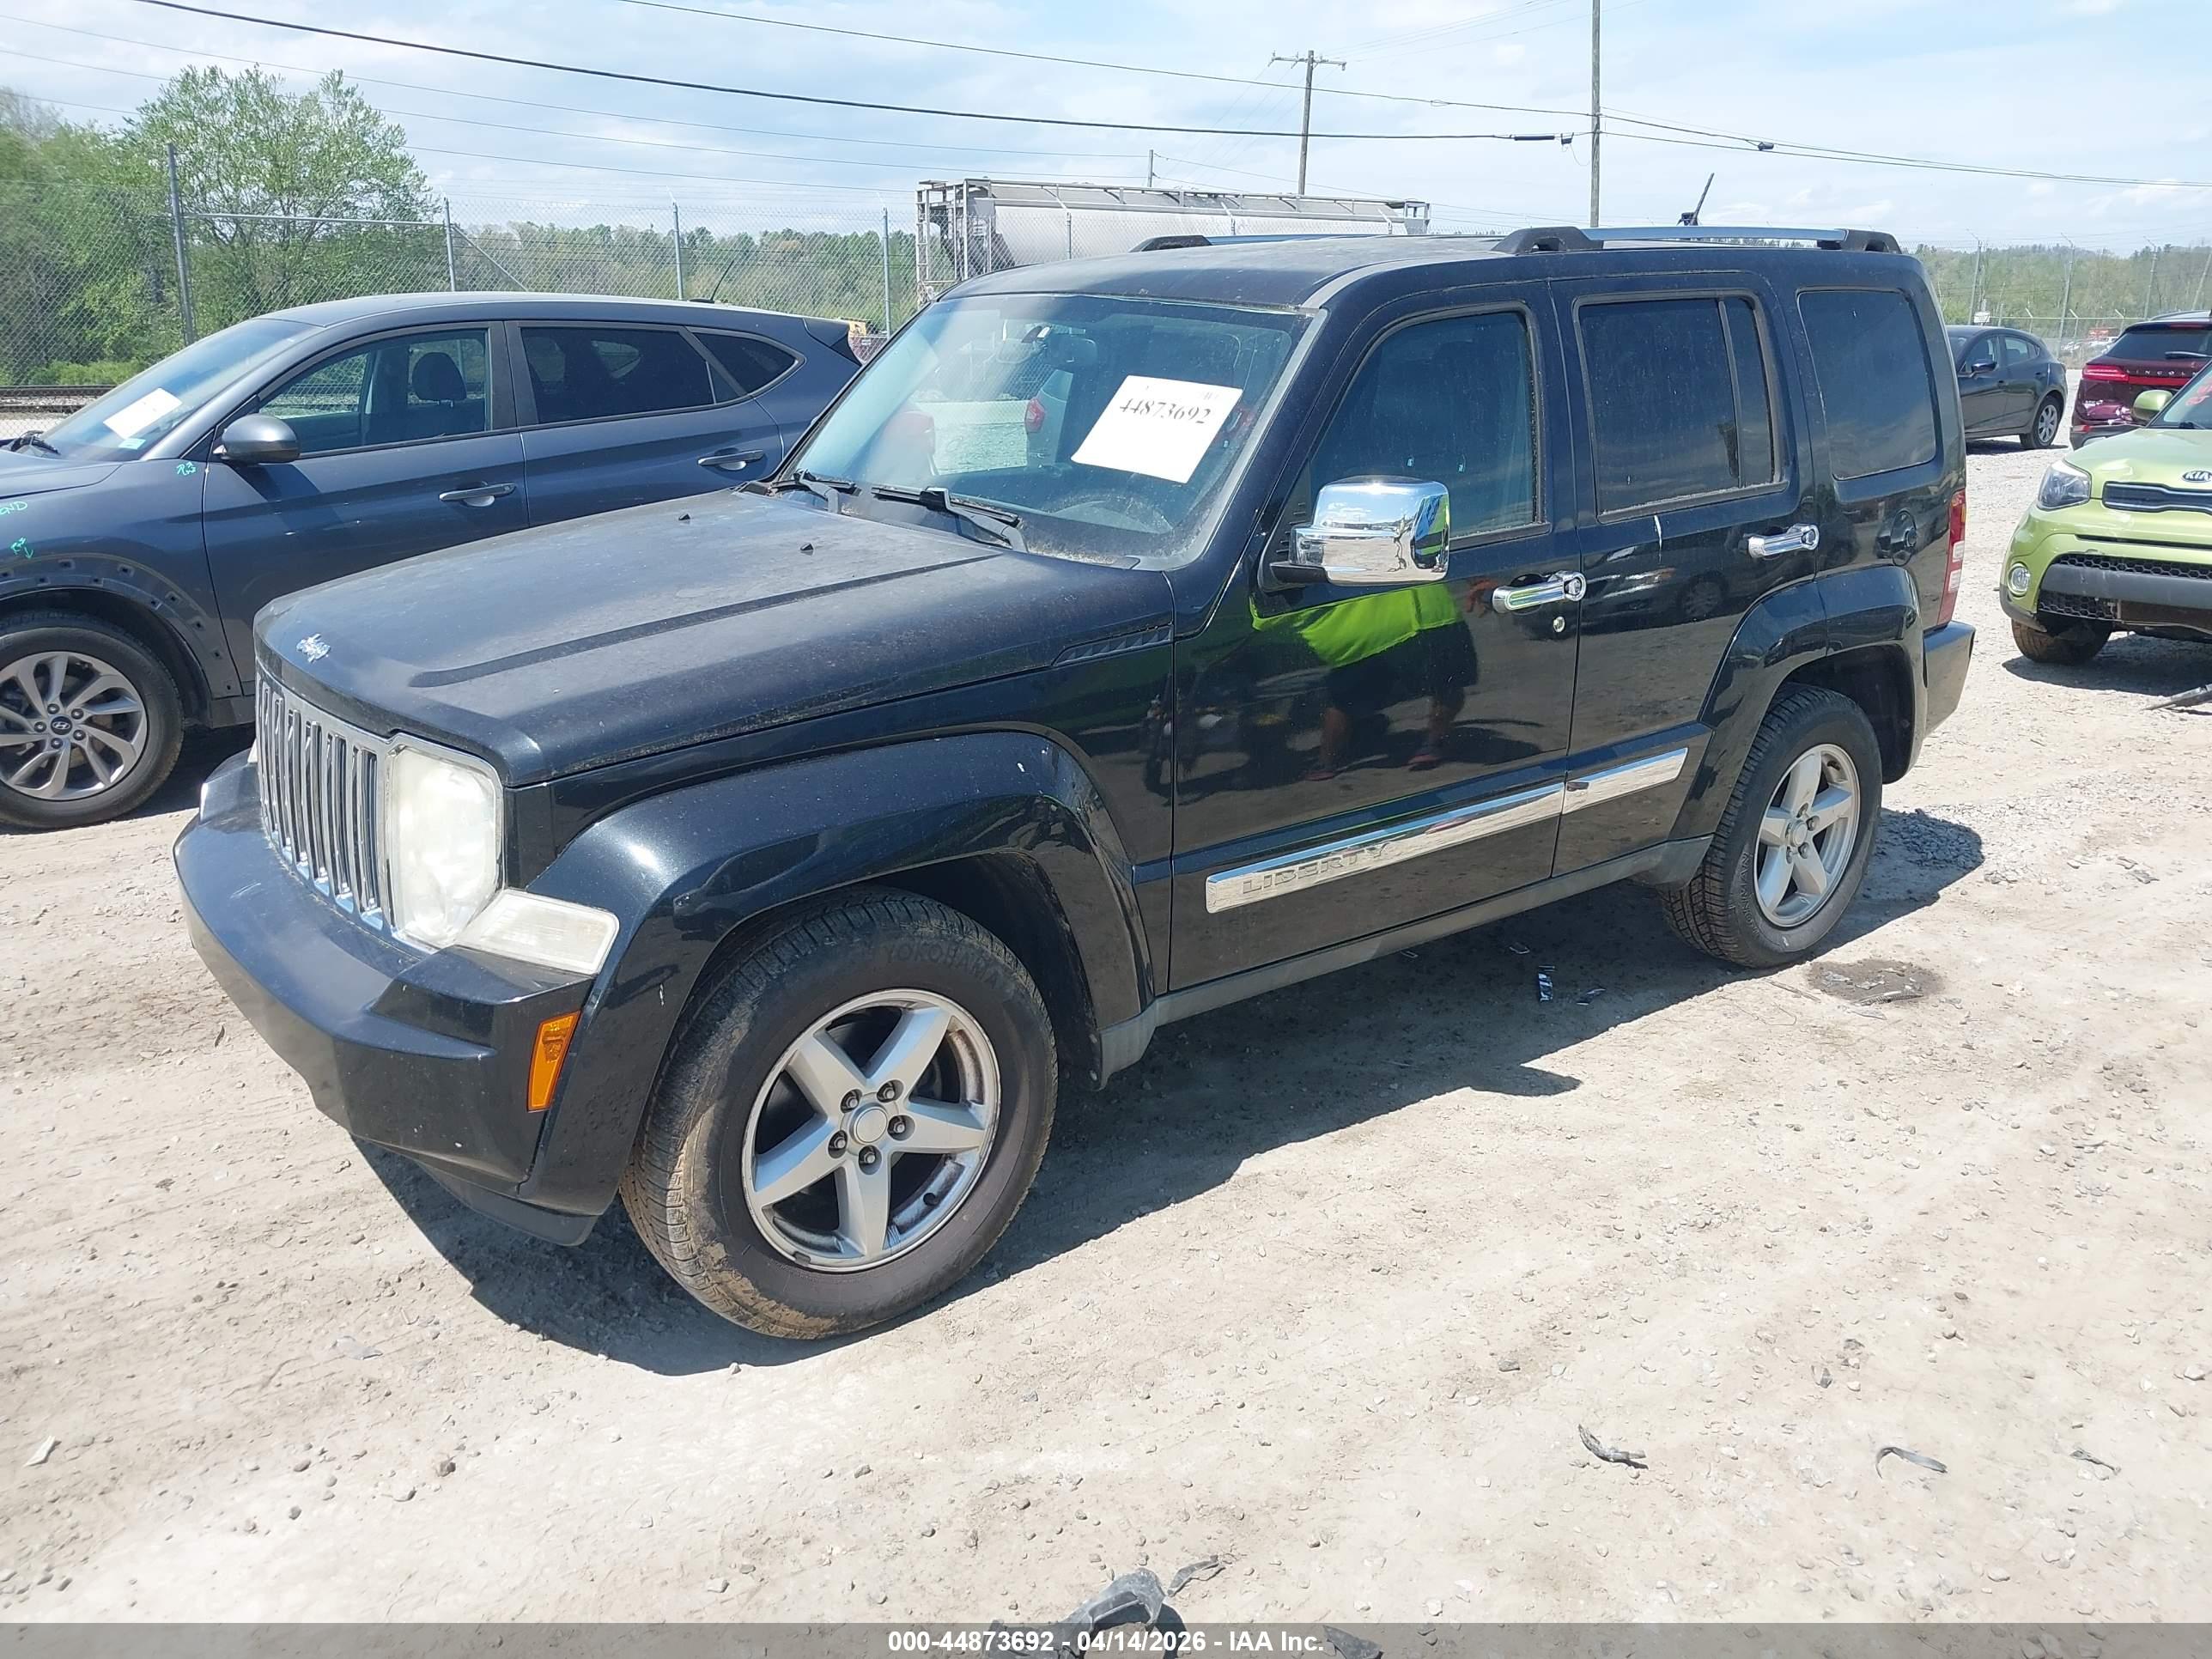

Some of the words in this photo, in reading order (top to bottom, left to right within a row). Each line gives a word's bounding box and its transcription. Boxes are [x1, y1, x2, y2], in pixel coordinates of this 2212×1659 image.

[1120, 398, 1211, 424] 44873692
[2184, 471, 2210, 482] KIA
[1243, 842, 1391, 895] LIBERTY
